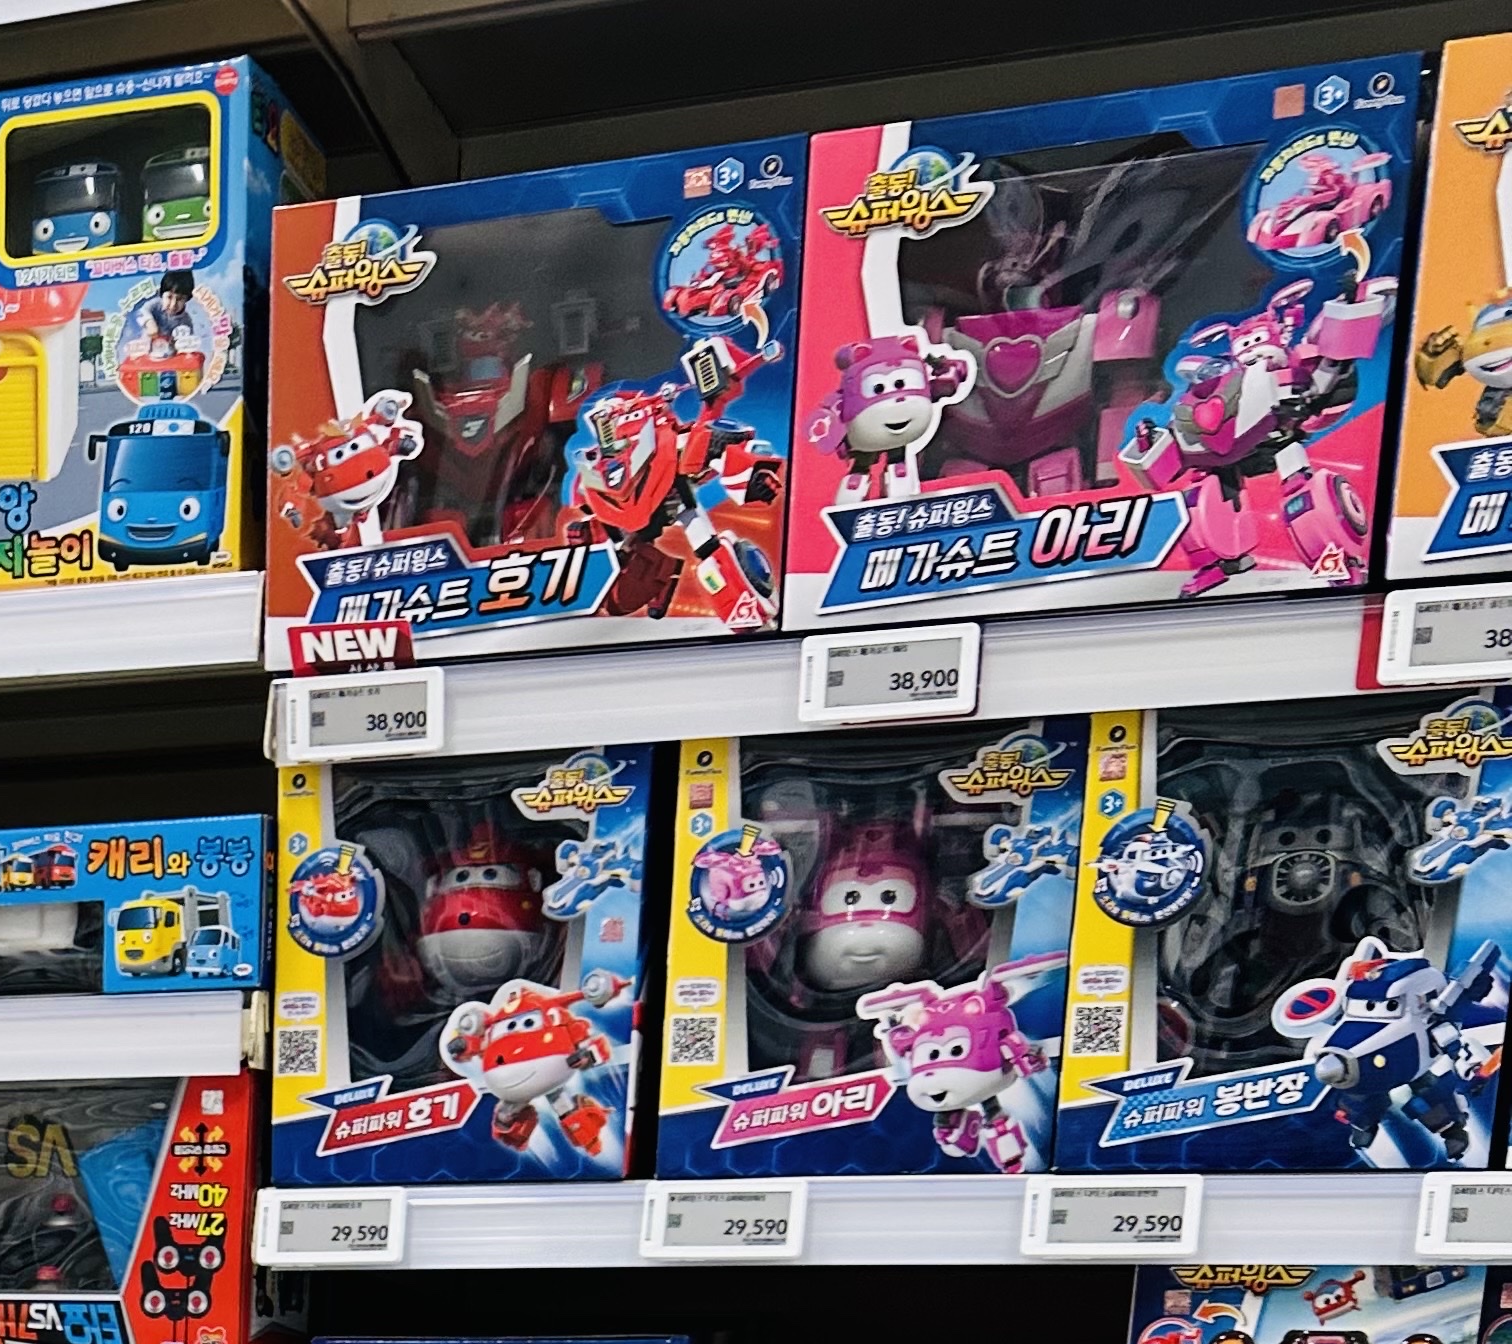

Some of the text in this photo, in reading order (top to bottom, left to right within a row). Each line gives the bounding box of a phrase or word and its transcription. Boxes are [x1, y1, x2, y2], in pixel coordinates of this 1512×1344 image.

[866, 170, 915, 200] 출동!
[820, 191, 986, 237] 슈퍼윙스
[324, 240, 367, 268] 출동!
[284, 257, 422, 300] 슈퍼윙스
[128, 422, 152, 434] 120
[854, 498, 994, 541] 출동! 슈퍼윙스
[858, 494, 1149, 593] 메가슈트 아리
[325, 545, 448, 587] 출동! 슈퍼윙스
[335, 545, 586, 626] 메가슈트 호기
[299, 626, 398, 665] NEW
[888, 667, 959, 692] 38,900
[365, 708, 427, 733] 38,900
[947, 764, 1074, 796] 슈퍼윙스
[518, 783, 633, 812] 슈퍼윙스
[195, 834, 254, 879] 봉봉
[332, 1086, 377, 1106] DELUXE
[730, 1076, 781, 1098] DELUXE
[1122, 1069, 1176, 1092] DELUXE
[334, 1087, 462, 1140] 슈퍼파워 호기
[731, 1077, 878, 1133] 슈퍼파워 아리
[1122, 1070, 1312, 1129] 슈퍼파워 봉반장
[6, 1122, 79, 1180] VS
[329, 1222, 389, 1244] 29,590
[722, 1216, 788, 1239] 29,590
[1112, 1212, 1183, 1236] 29,590
